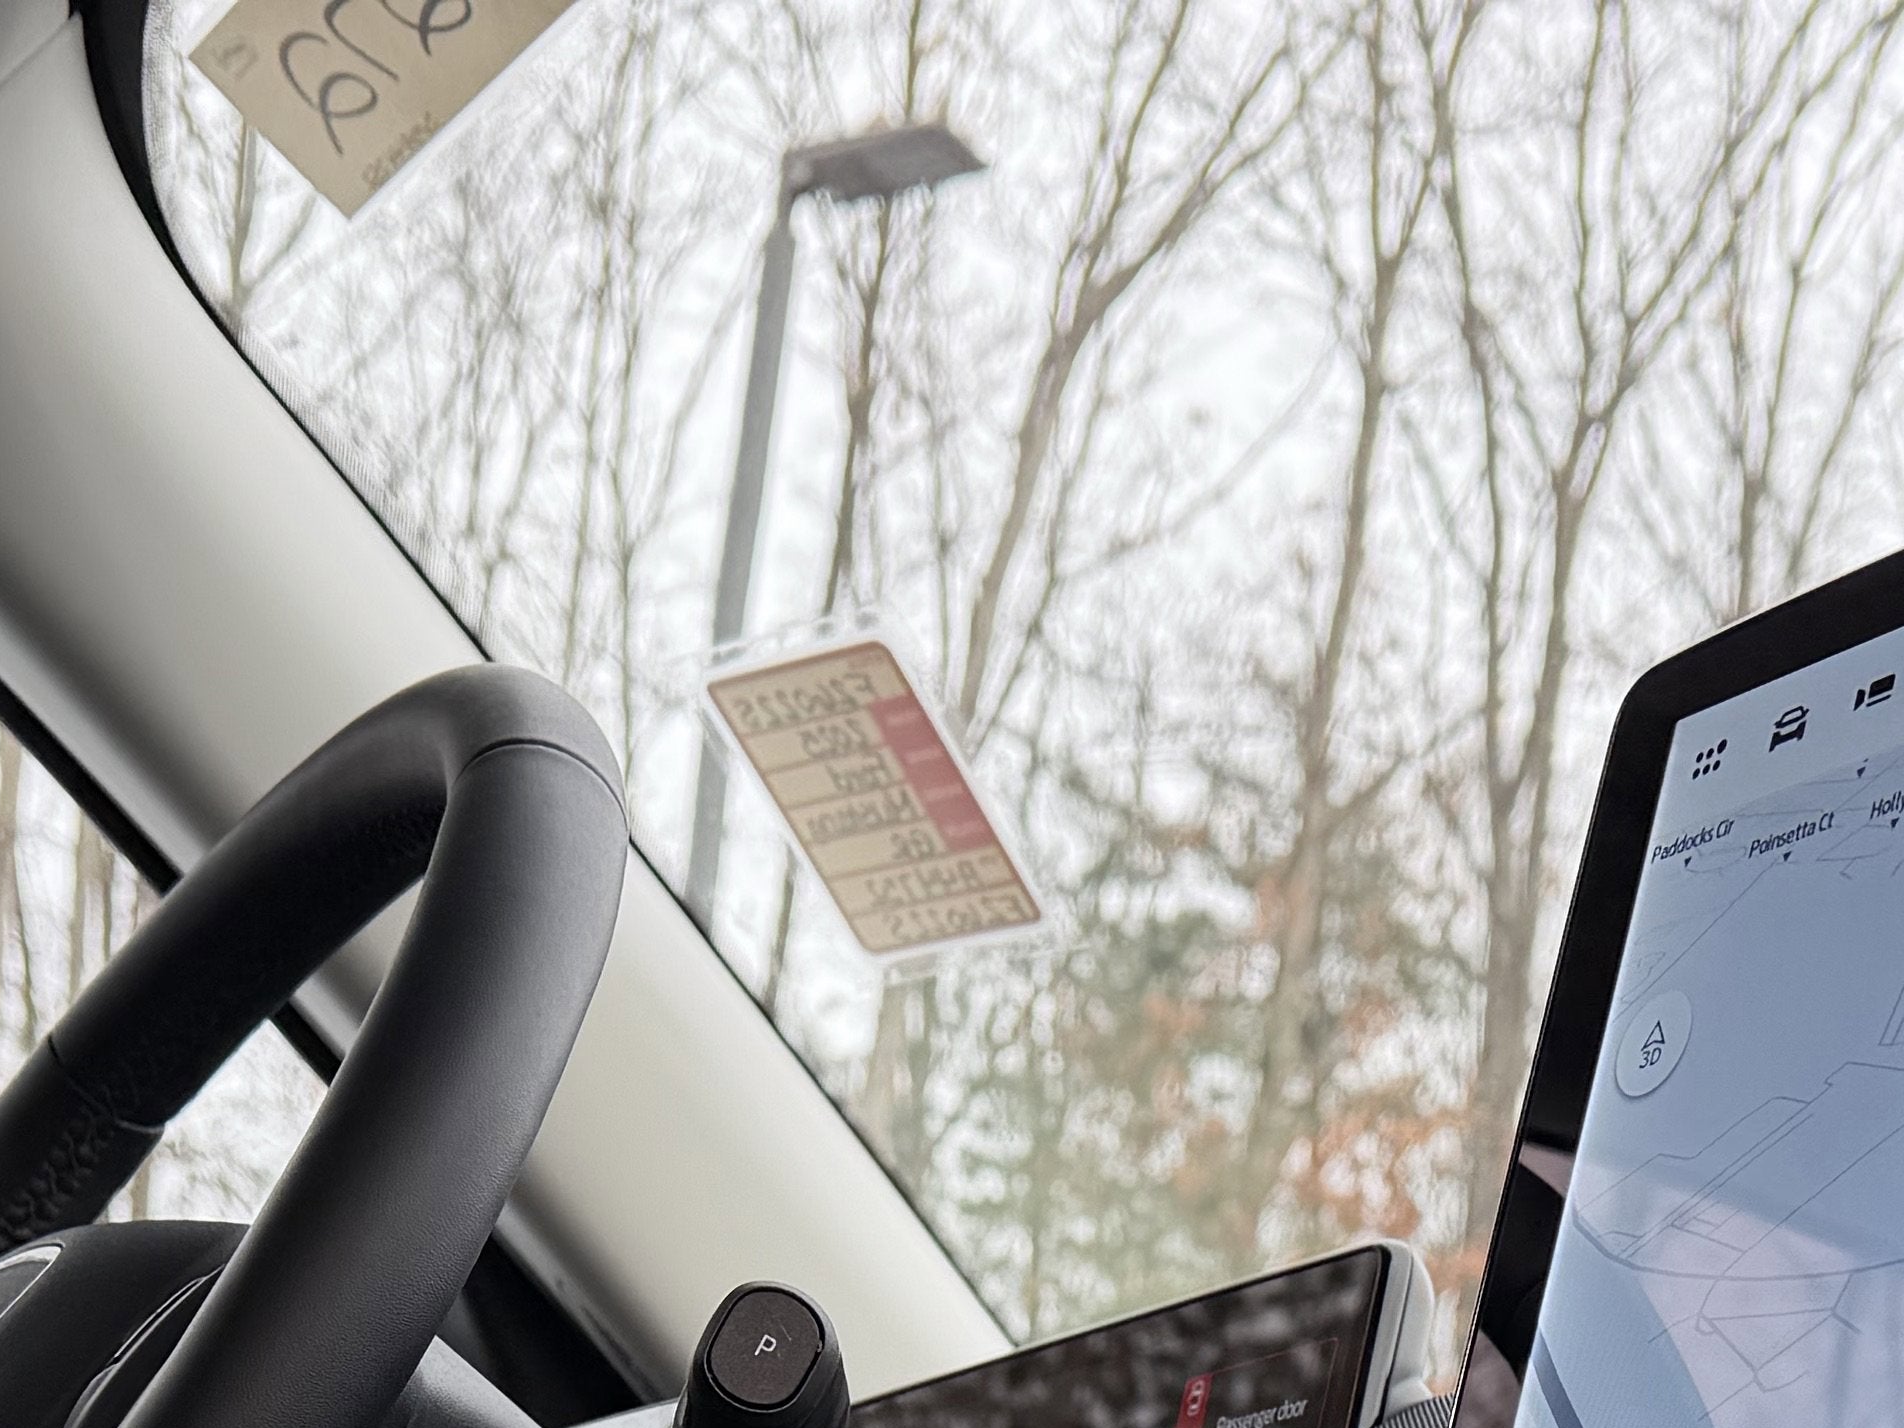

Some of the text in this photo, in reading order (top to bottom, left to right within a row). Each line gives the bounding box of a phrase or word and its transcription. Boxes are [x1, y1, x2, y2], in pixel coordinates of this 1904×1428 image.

[1651, 824, 1713, 864] Paddocks
[1748, 811, 1835, 858] Poinsetta Ct
[1639, 1047, 1661, 1069] 3D
[754, 1334, 777, 1356] P
[1277, 1400, 1308, 1420] door
